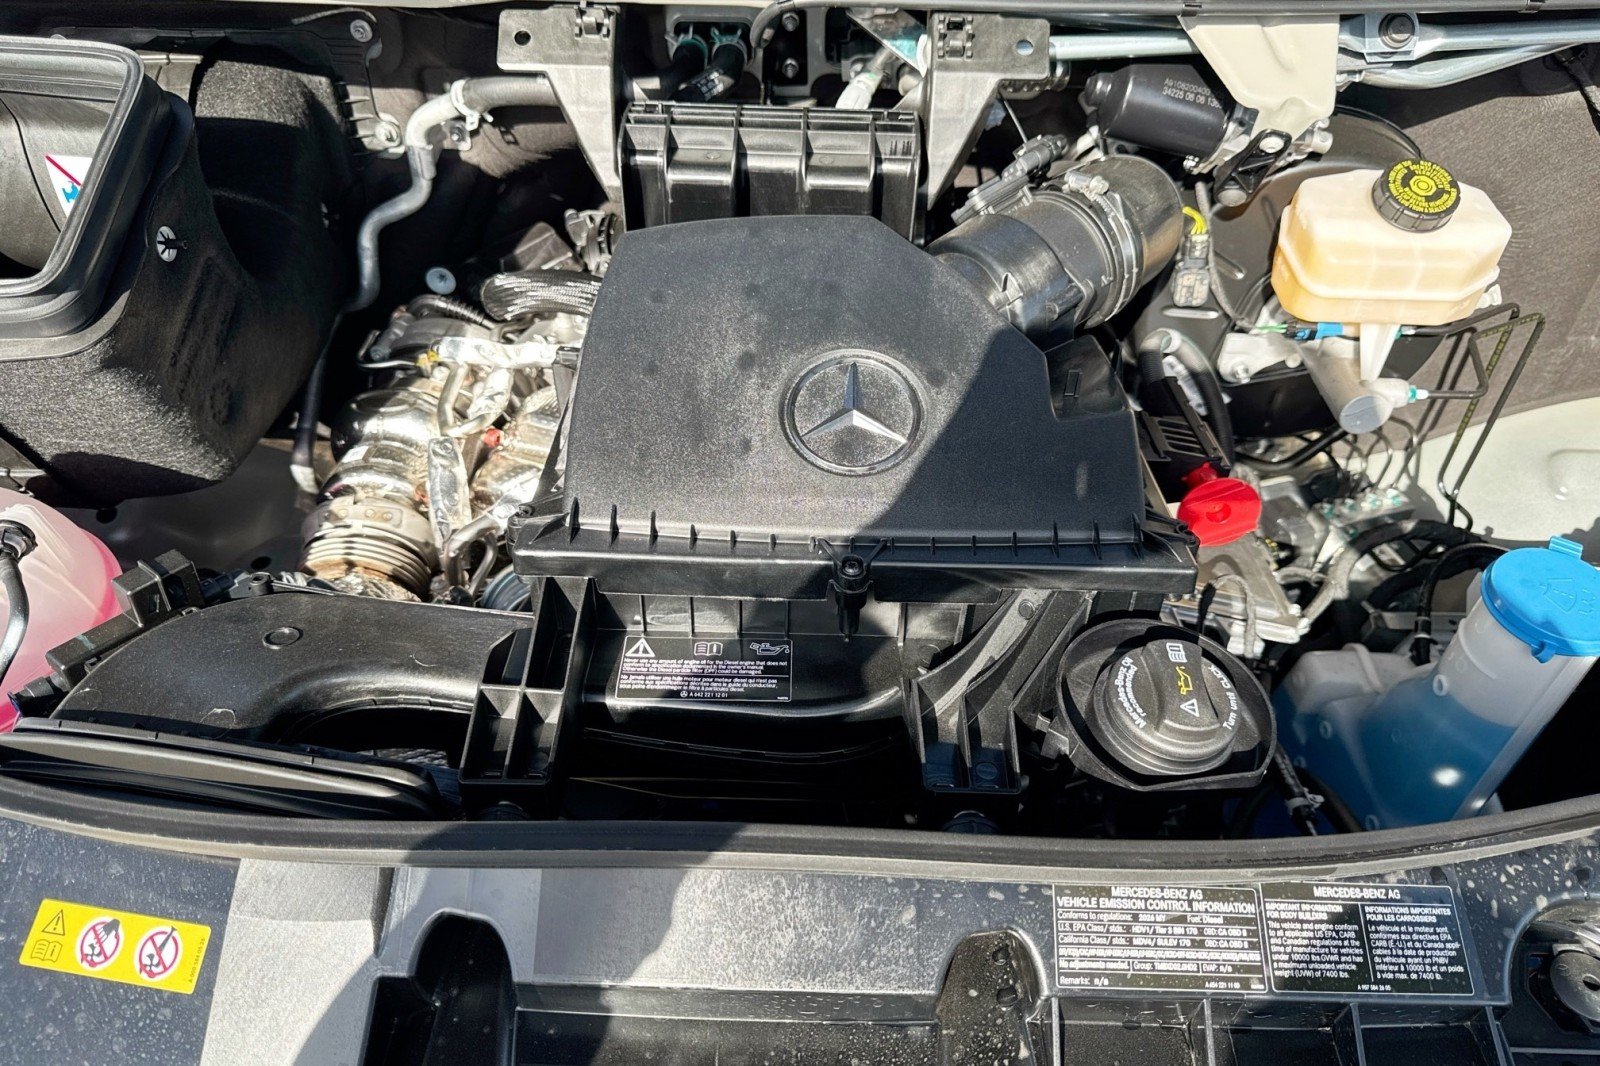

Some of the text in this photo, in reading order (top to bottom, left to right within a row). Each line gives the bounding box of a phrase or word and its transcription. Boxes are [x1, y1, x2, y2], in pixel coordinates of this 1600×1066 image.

[1114, 664, 1147, 728] Mercedes-Benz
[1208, 664, 1238, 730] Turn until CLICK
[1111, 886, 1203, 900] MERCEDES-BENZ AG
[1313, 886, 1400, 899] MERCEDES-BENZ AG
[1057, 896, 1255, 913] VEHICLE EMISSION CONTROL INFORMATION
[1265, 903, 1343, 912] IMPORTANT INFORMATION
[1365, 906, 1451, 915] INFORMATIONS IMPORTANTES
[1298, 912, 1328, 920] BUILDERS
[1396, 914, 1437, 923] CARROSSIERS
[1073, 924, 1086, 932] EPA
[1094, 977, 1109, 986] n/a
